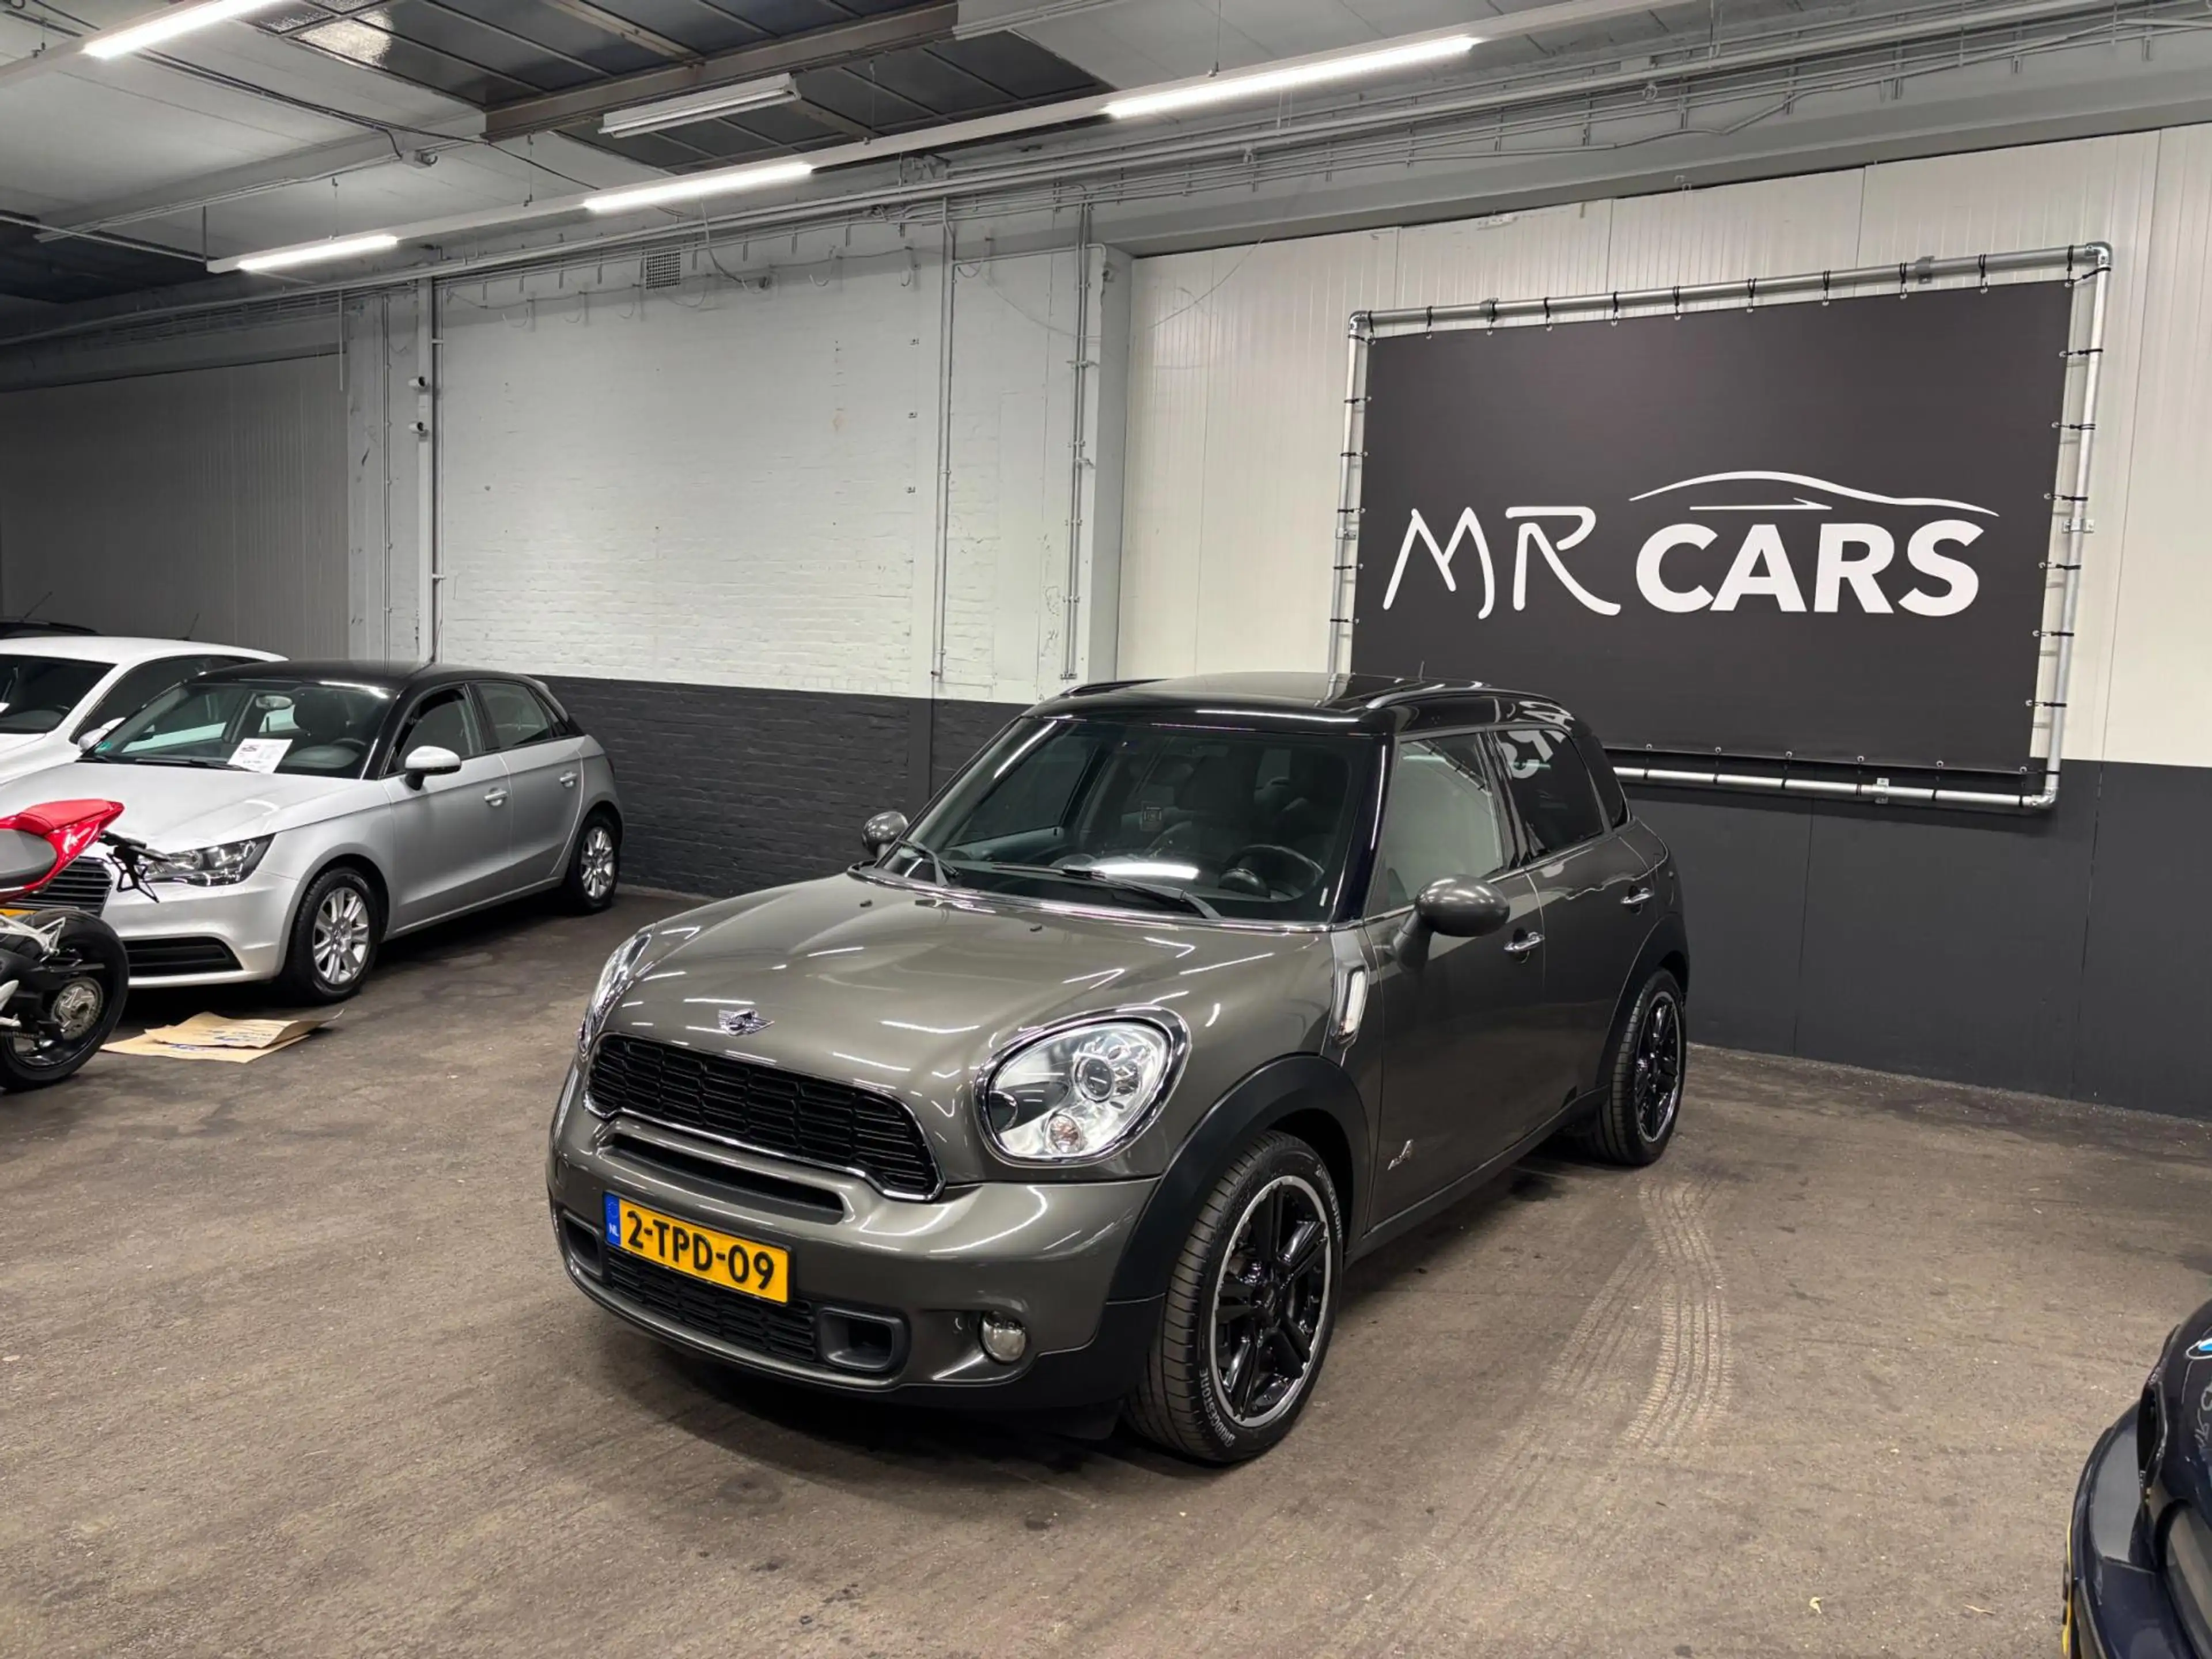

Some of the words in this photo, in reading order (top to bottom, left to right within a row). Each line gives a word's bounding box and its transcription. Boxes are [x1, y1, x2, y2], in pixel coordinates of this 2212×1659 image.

[1383, 506, 1620, 619] MR
[1636, 520, 1984, 616] CARS
[609, 1223, 620, 1237] NL
[627, 1210, 774, 1290] 2-TPD-09
